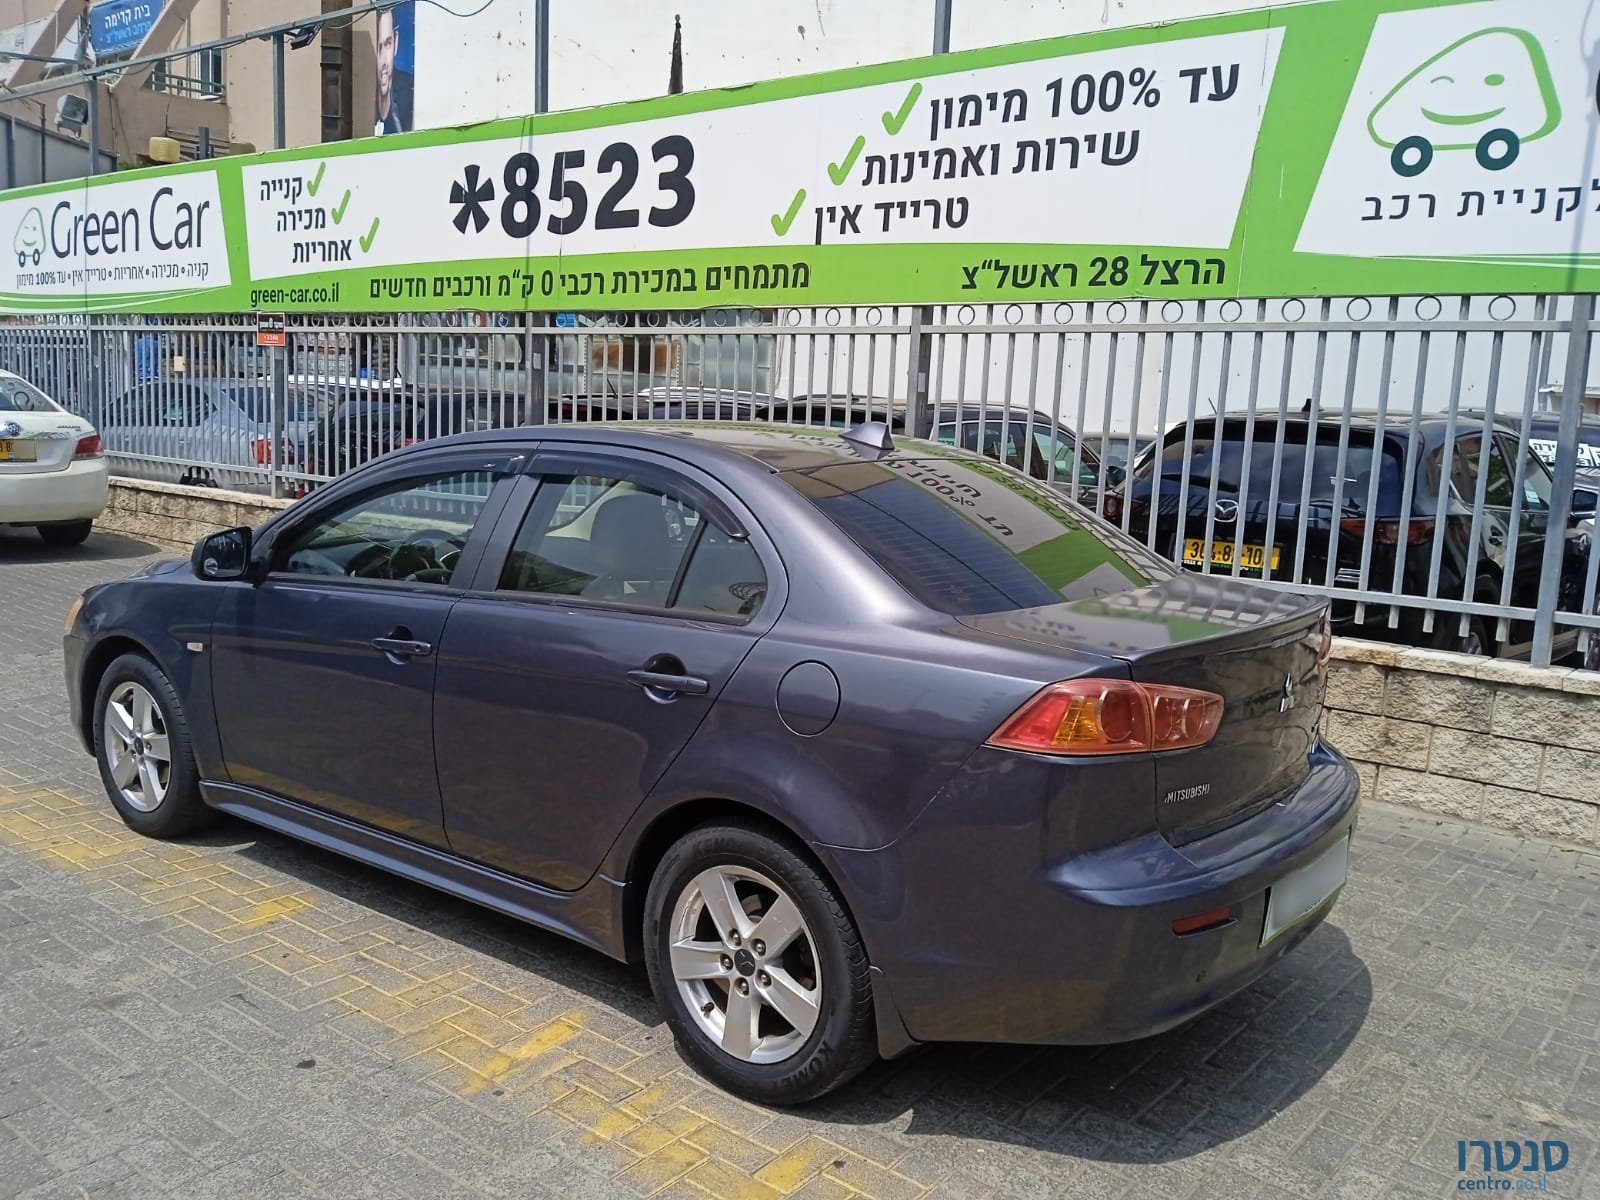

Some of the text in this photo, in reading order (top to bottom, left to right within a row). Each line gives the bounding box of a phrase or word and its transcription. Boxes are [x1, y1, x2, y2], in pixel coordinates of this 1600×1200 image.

[134, 4, 151, 20] בית
[930, 64, 1239, 141] עד 100% מימון
[861, 130, 1139, 186] שירות ואמינות
[260, 177, 302, 202] קנייה
[277, 206, 326, 232] מכירה
[1362, 194, 1435, 220] רכב
[51, 187, 209, 258] Green Car
[815, 197, 968, 246] טרייד אין
[293, 240, 352, 263] אחריות
[17, 263, 208, 289] קניה מכירה אחריות טרייד אין עד 100% מימון
[611, 269, 697, 294] במכירת
[705, 263, 809, 290] מתמחים
[1088, 256, 1128, 286] 28
[1141, 254, 1225, 285] הרצל
[251, 283, 339, 306] green-car.co.il
[370, 278, 426, 298] חדשים
[433, 276, 490, 296] ורכבים
[542, 270, 553, 296] 0
[560, 273, 604, 295] רכבי
[1164, 783, 1210, 804] MITSUBISHI
